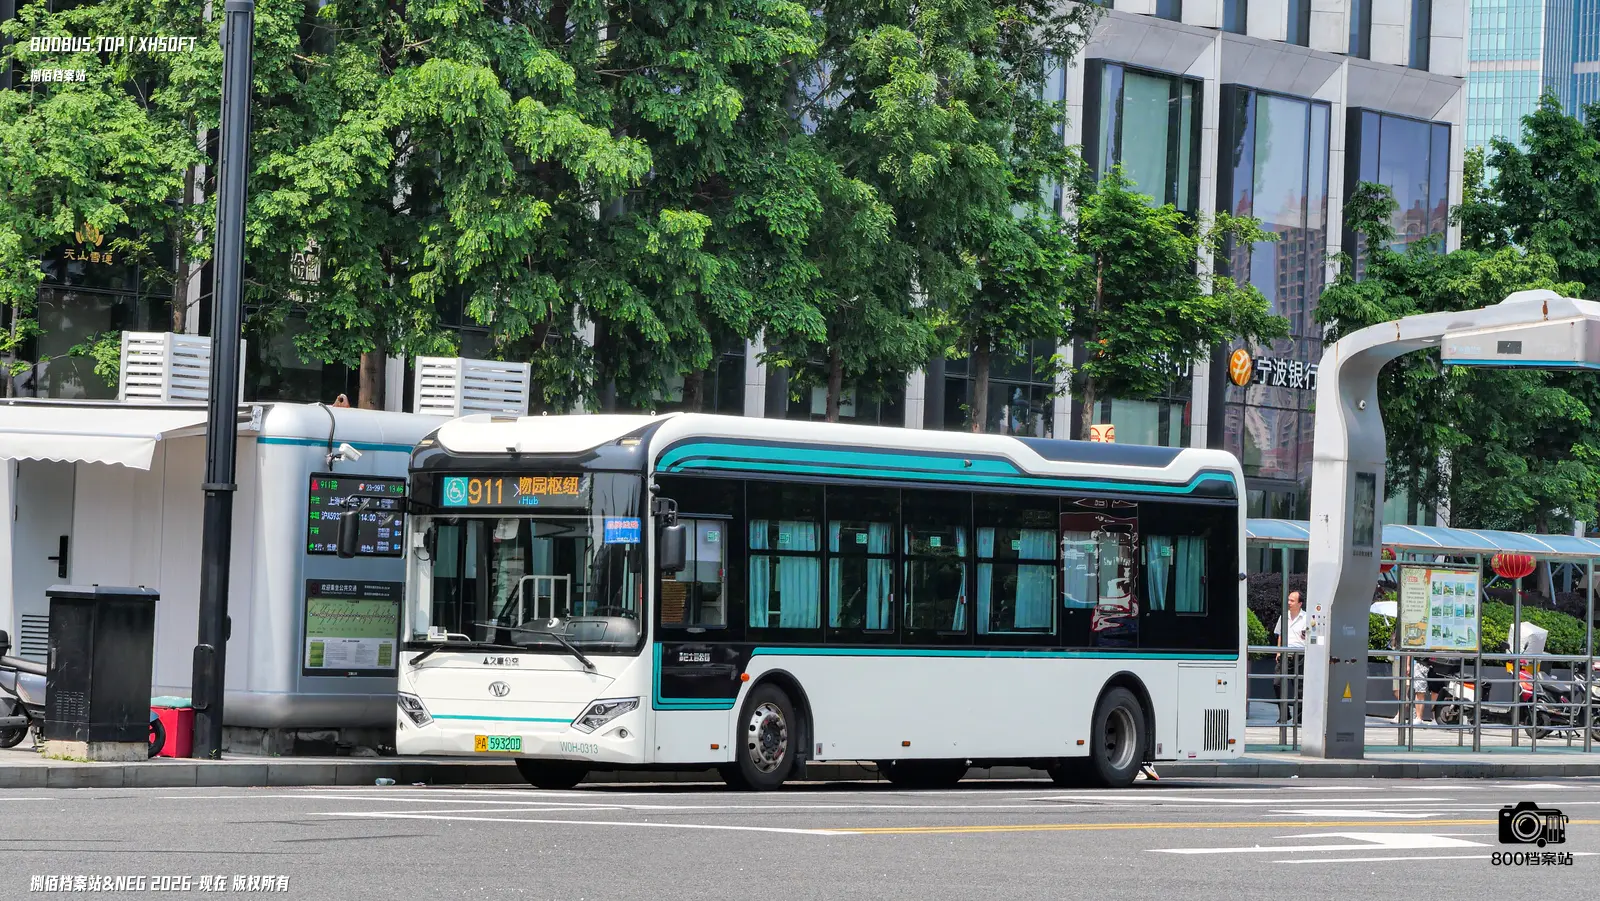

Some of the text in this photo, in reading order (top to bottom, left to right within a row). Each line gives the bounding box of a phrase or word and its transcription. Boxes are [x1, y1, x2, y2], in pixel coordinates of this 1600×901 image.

[1256, 358, 1318, 390] 宁波银行
[468, 478, 502, 504] 911
[522, 497, 539, 505] Hub
